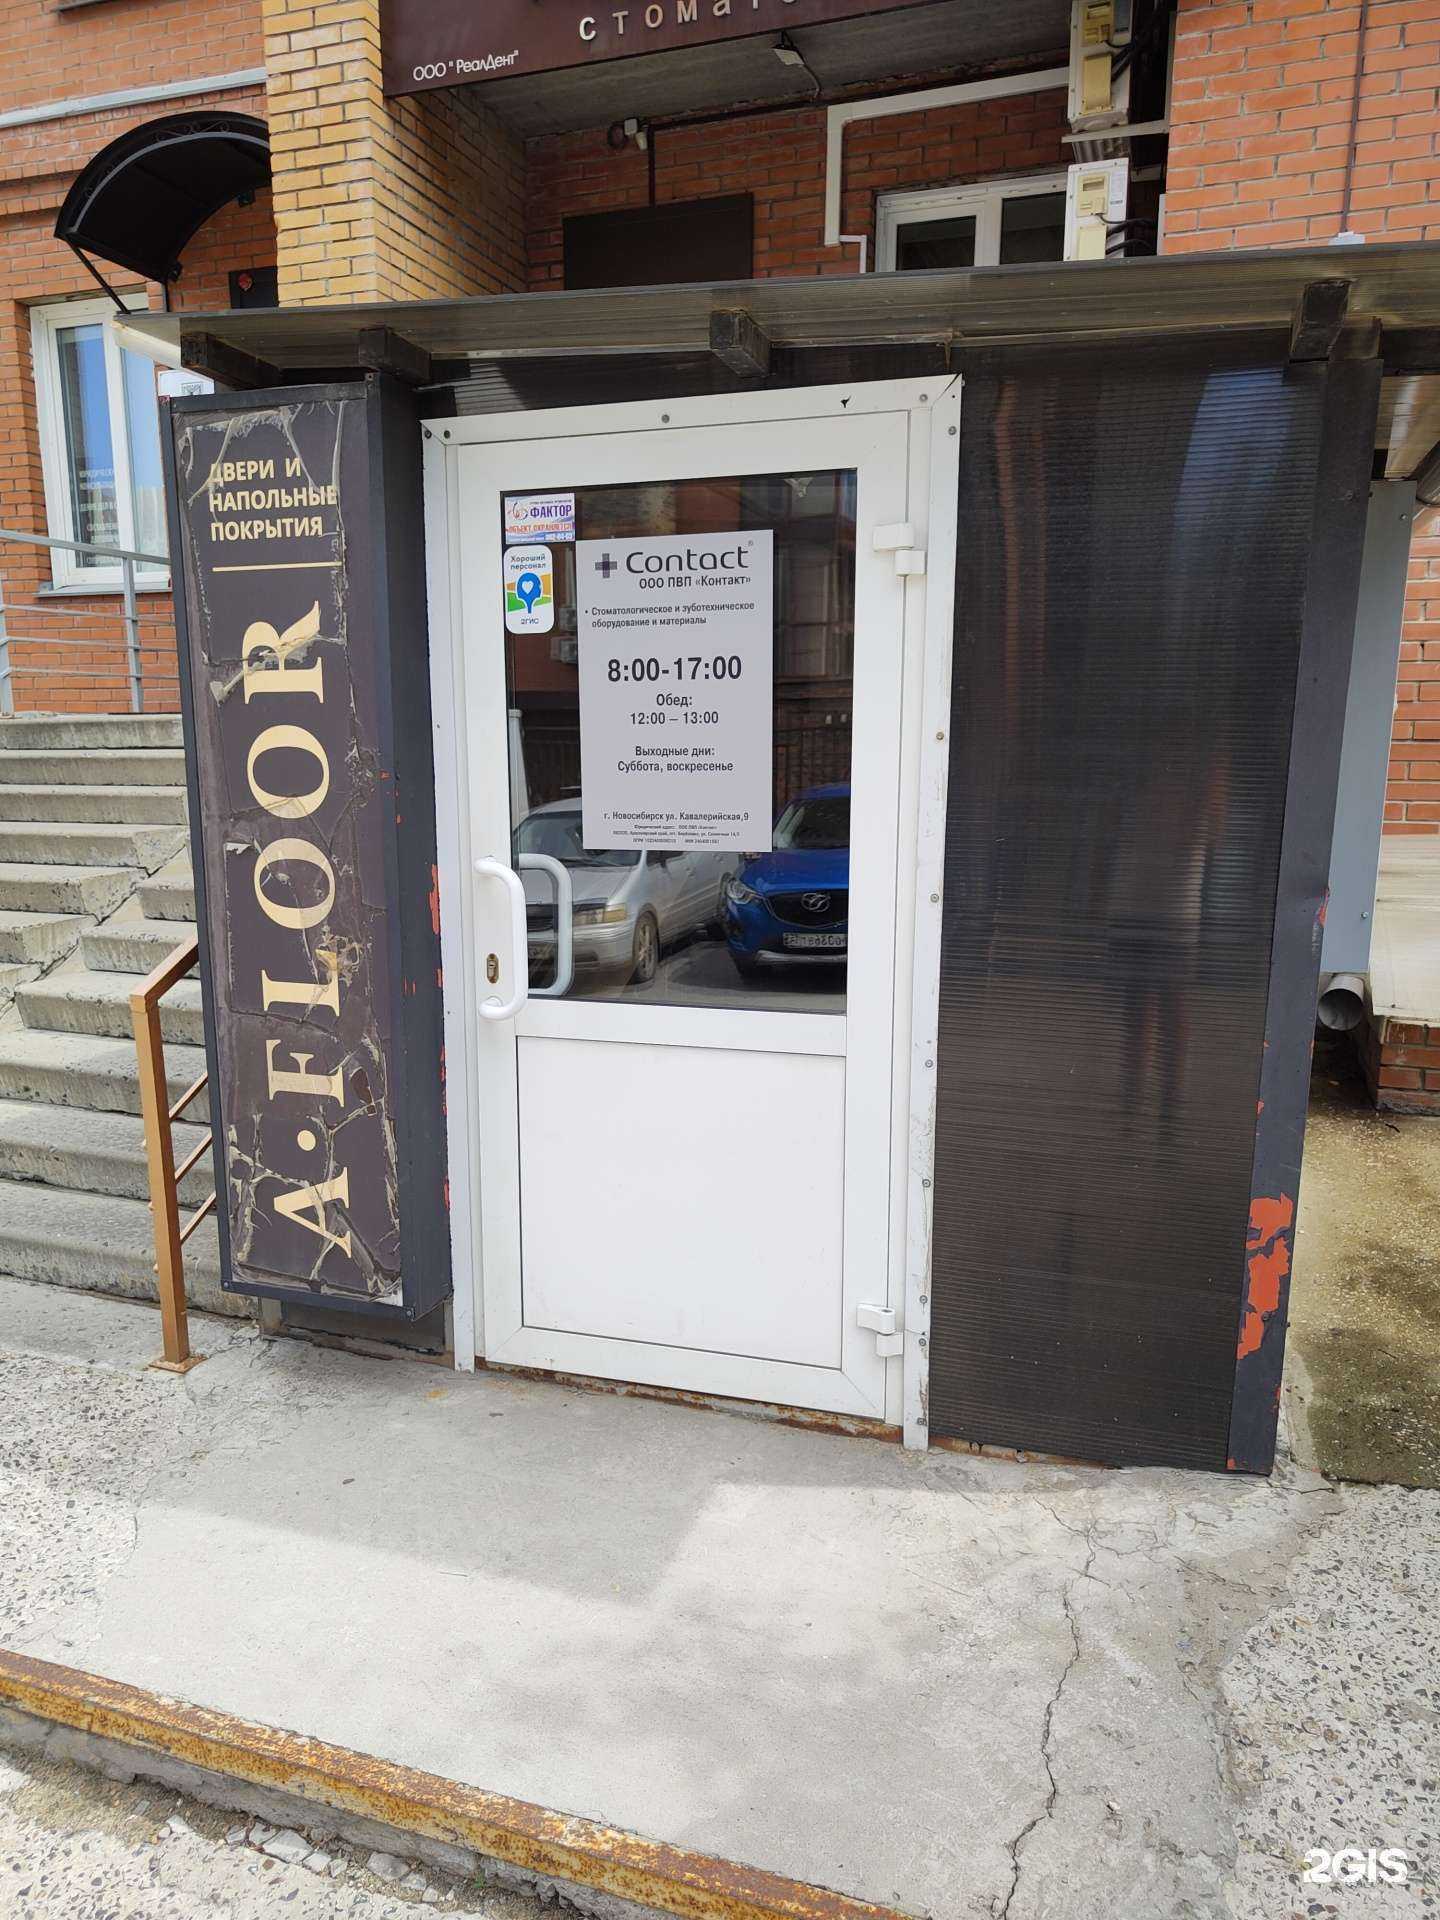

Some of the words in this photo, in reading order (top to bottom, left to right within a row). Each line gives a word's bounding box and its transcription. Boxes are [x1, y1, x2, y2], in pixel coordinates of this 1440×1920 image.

[413, 62, 447, 81] ООО
[209, 459, 275, 486] ДВЕРИ
[285, 457, 301, 478] И
[209, 485, 338, 512] НАПОЛЬНЫЕ
[530, 505, 572, 518] ФАКТОР
[210, 516, 323, 541] ПОКРЫТИЯ
[511, 554, 546, 563] Хороший
[626, 546, 749, 574] Contact
[510, 563, 546, 571] персонал
[639, 578, 664, 589] ООО
[668, 576, 692, 588] ПВП
[695, 574, 751, 587] «Контакт»
[591, 606, 673, 616] Стоматологическое
[675, 605, 681, 613] и
[682, 602, 755, 613] зуботехническое
[521, 617, 539, 625] 2ГИС
[592, 618, 650, 629] оборудование
[652, 618, 657, 626] и
[659, 616, 707, 627] материалы
[607, 655, 742, 682] 8:00-17:00
[656, 693, 693, 707] Обед:
[630, 712, 666, 724] 12:00
[683, 711, 719, 724] 13:00
[635, 746, 689, 757] Выходные
[691, 747, 715, 757] дни:
[617, 760, 663, 773] Суббота,
[666, 762, 734, 772] воскресенье
[604, 812, 611, 820] г.
[613, 811, 664, 821] Новосибирск
[665, 812, 678, 822] ул.
